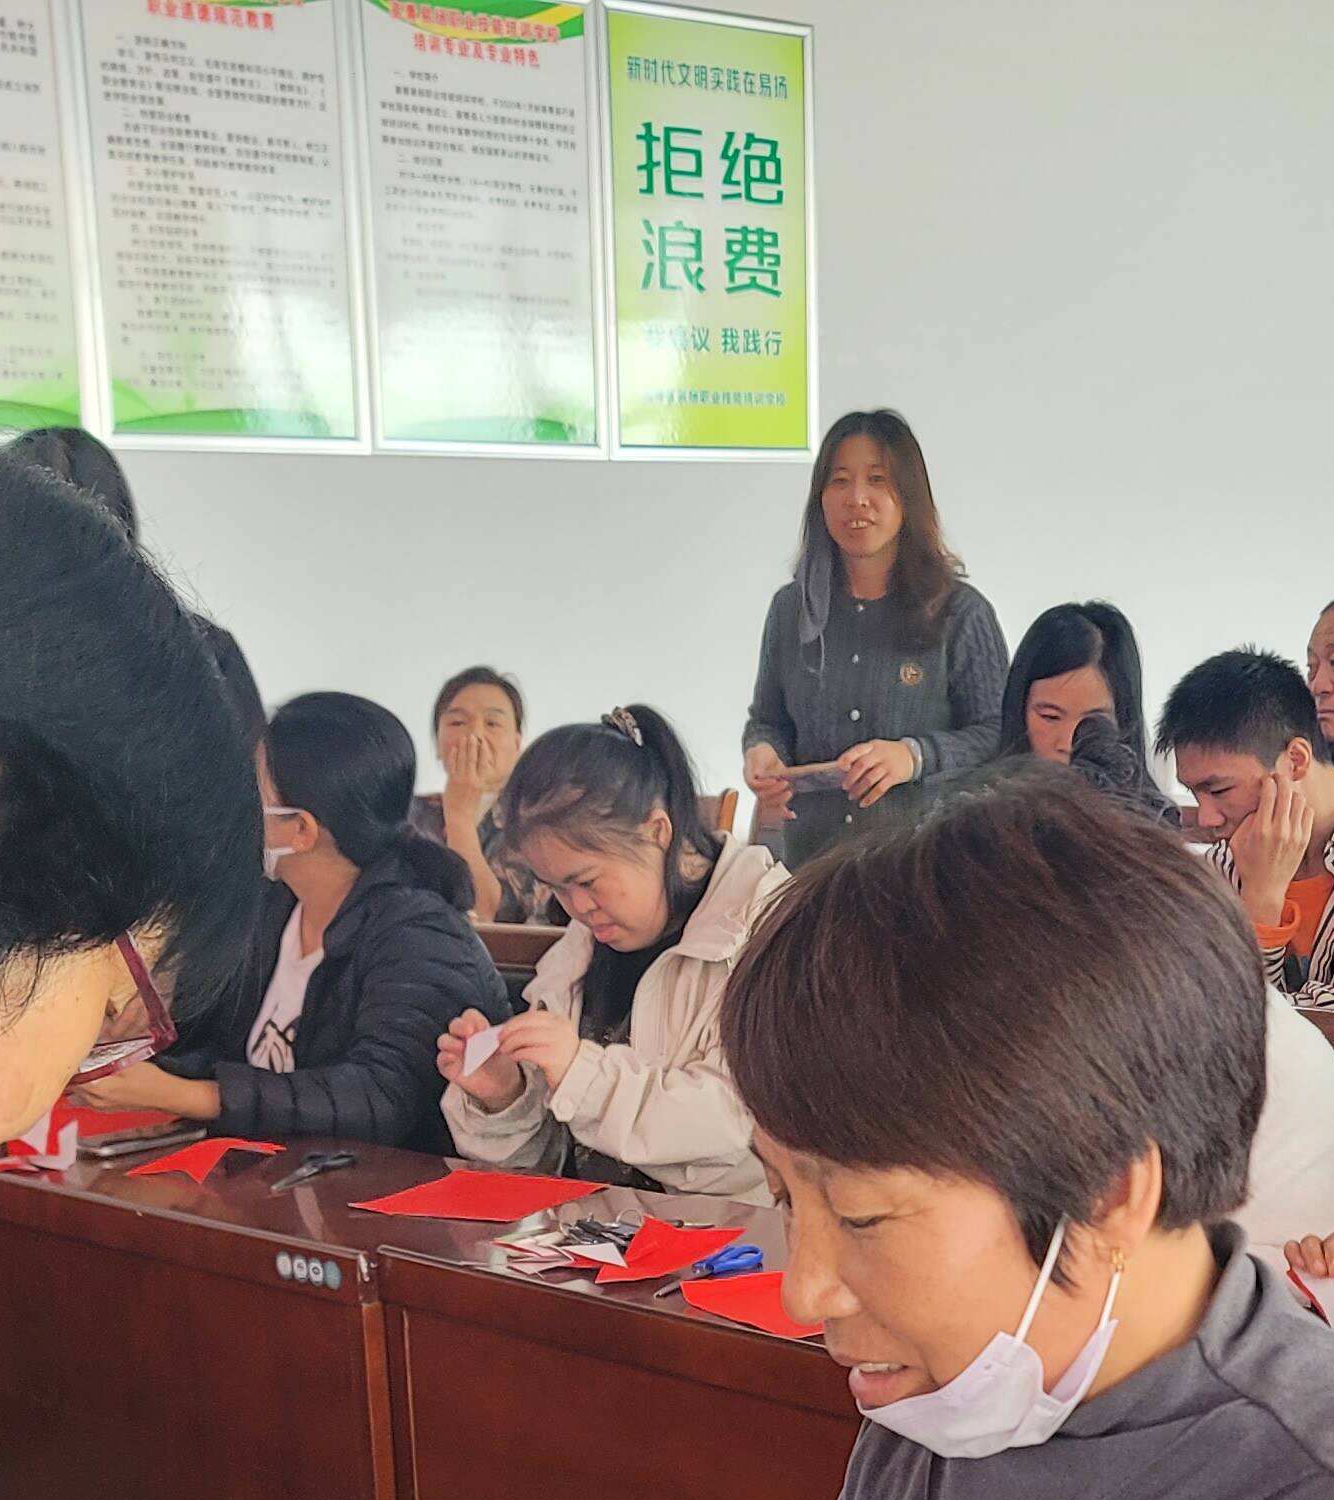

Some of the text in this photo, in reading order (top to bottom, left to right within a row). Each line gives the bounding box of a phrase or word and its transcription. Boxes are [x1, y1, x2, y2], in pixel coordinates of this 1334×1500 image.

[636, 122, 783, 205] 拒绝
[642, 219, 783, 298] 浪费
[721, 326, 783, 357] 我践行
